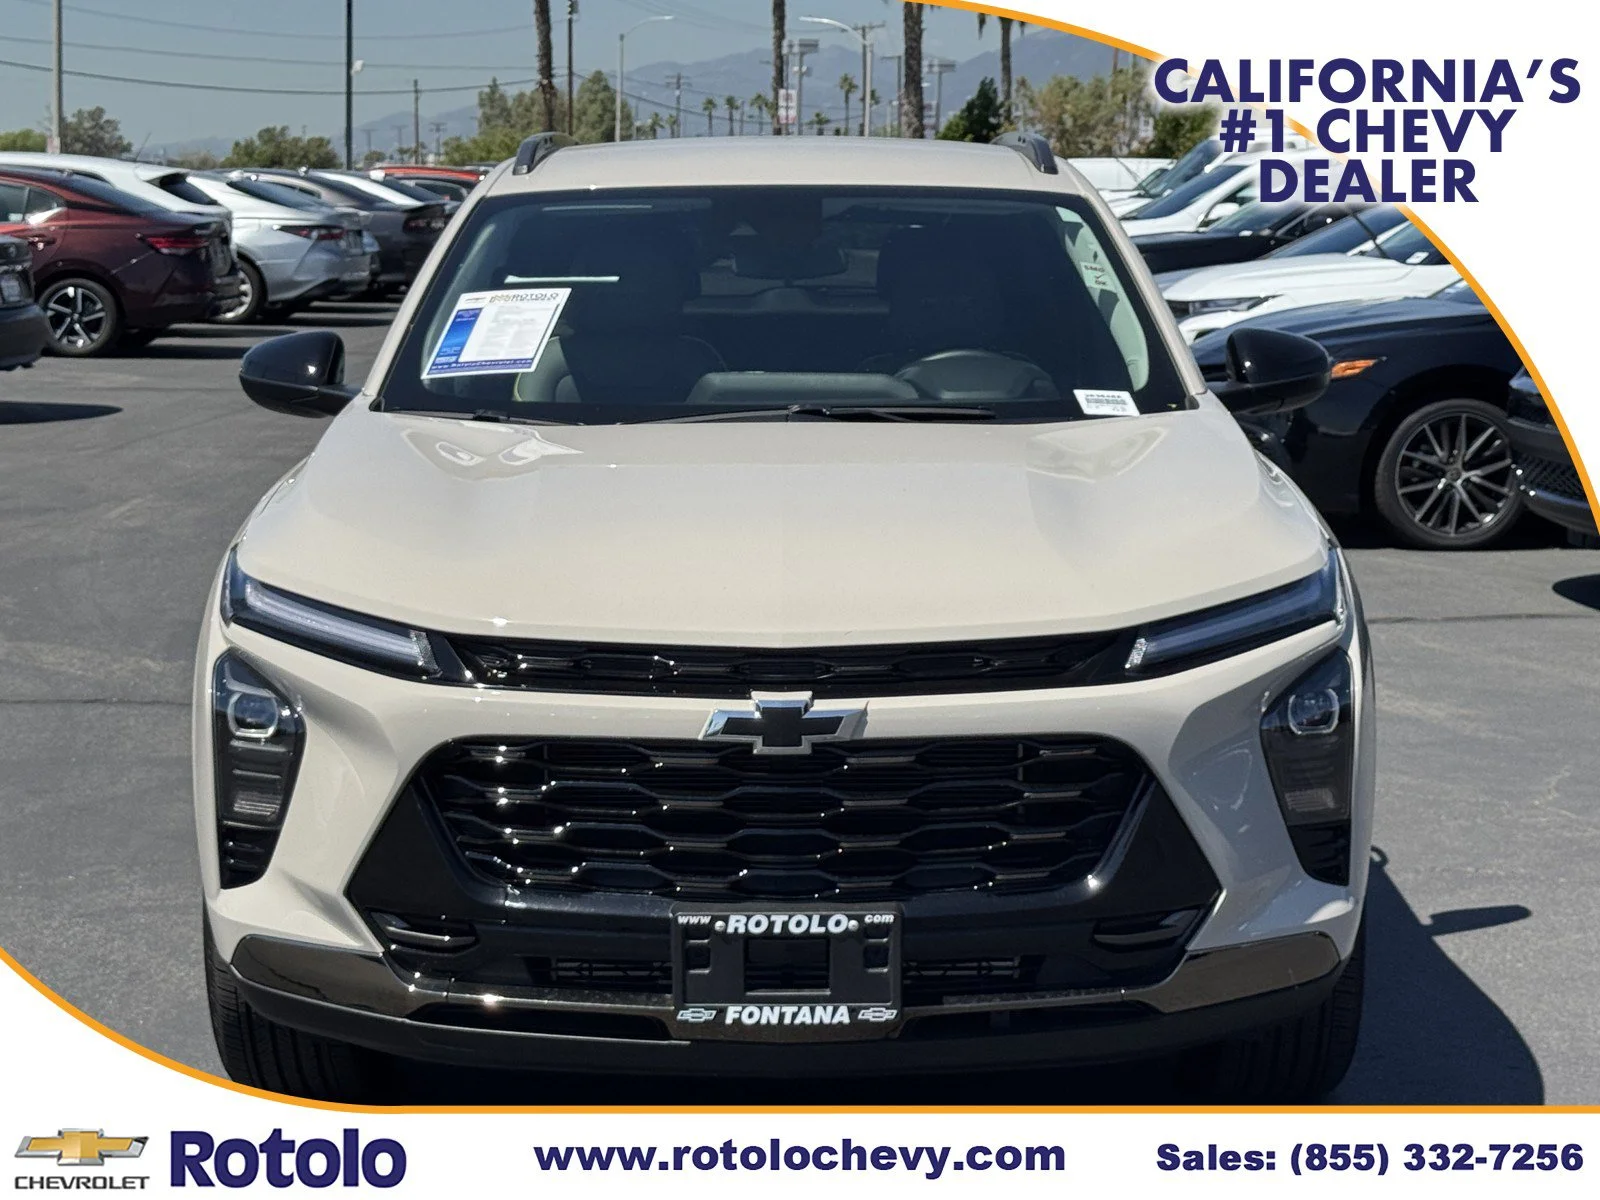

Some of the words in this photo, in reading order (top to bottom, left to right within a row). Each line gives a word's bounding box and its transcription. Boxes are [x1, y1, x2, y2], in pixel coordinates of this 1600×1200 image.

[726, 913, 849, 934] ROTOLO
[864, 913, 895, 924] com
[725, 1004, 851, 1025] FONTANA
